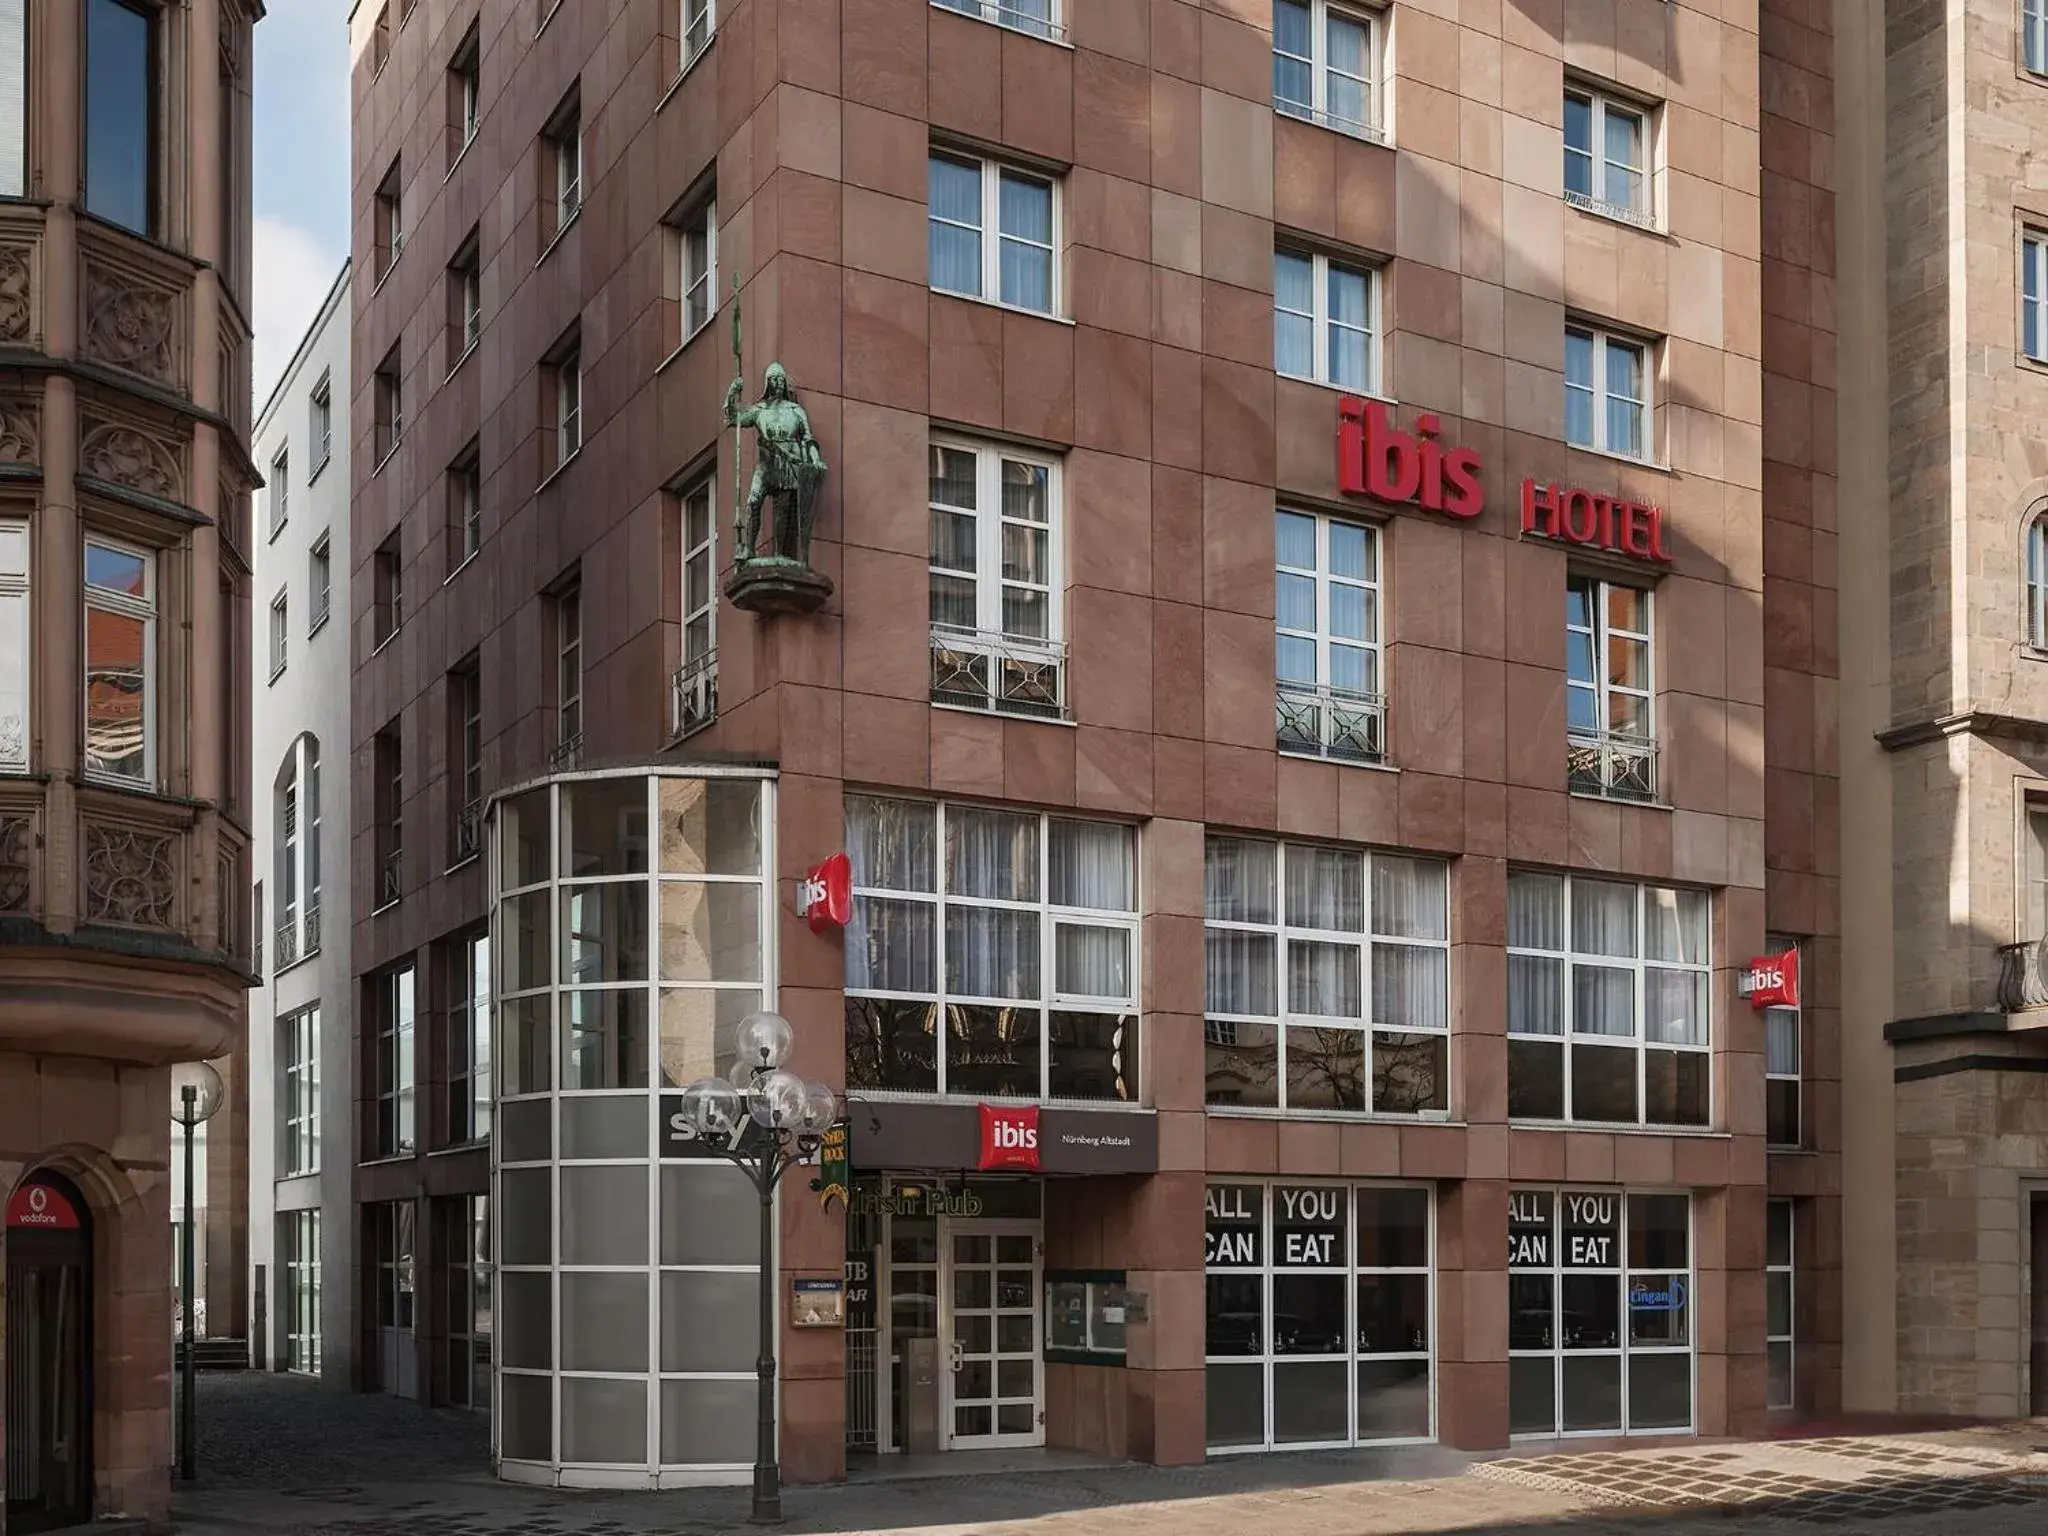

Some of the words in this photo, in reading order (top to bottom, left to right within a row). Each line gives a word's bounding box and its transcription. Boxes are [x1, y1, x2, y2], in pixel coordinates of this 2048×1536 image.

[1337, 395, 1484, 520] ibis
[1521, 476, 1673, 561] HOTEL
[1751, 966, 1784, 991] ibis
[993, 1120, 1038, 1149] ibis
[1061, 1133, 1100, 1147] Nürnberg
[1100, 1135, 1131, 1147] Altstadt
[926, 1187, 984, 1217] Pub
[1204, 1187, 1252, 1219] ALL
[1281, 1190, 1337, 1221] YOU
[1507, 1194, 1546, 1223] ALL
[1568, 1195, 1613, 1225] YOU
[20, 1212, 57, 1224] vodafone
[1204, 1231, 1254, 1263] CAN
[1286, 1233, 1335, 1263] EAT
[1571, 1235, 1611, 1265] EAT
